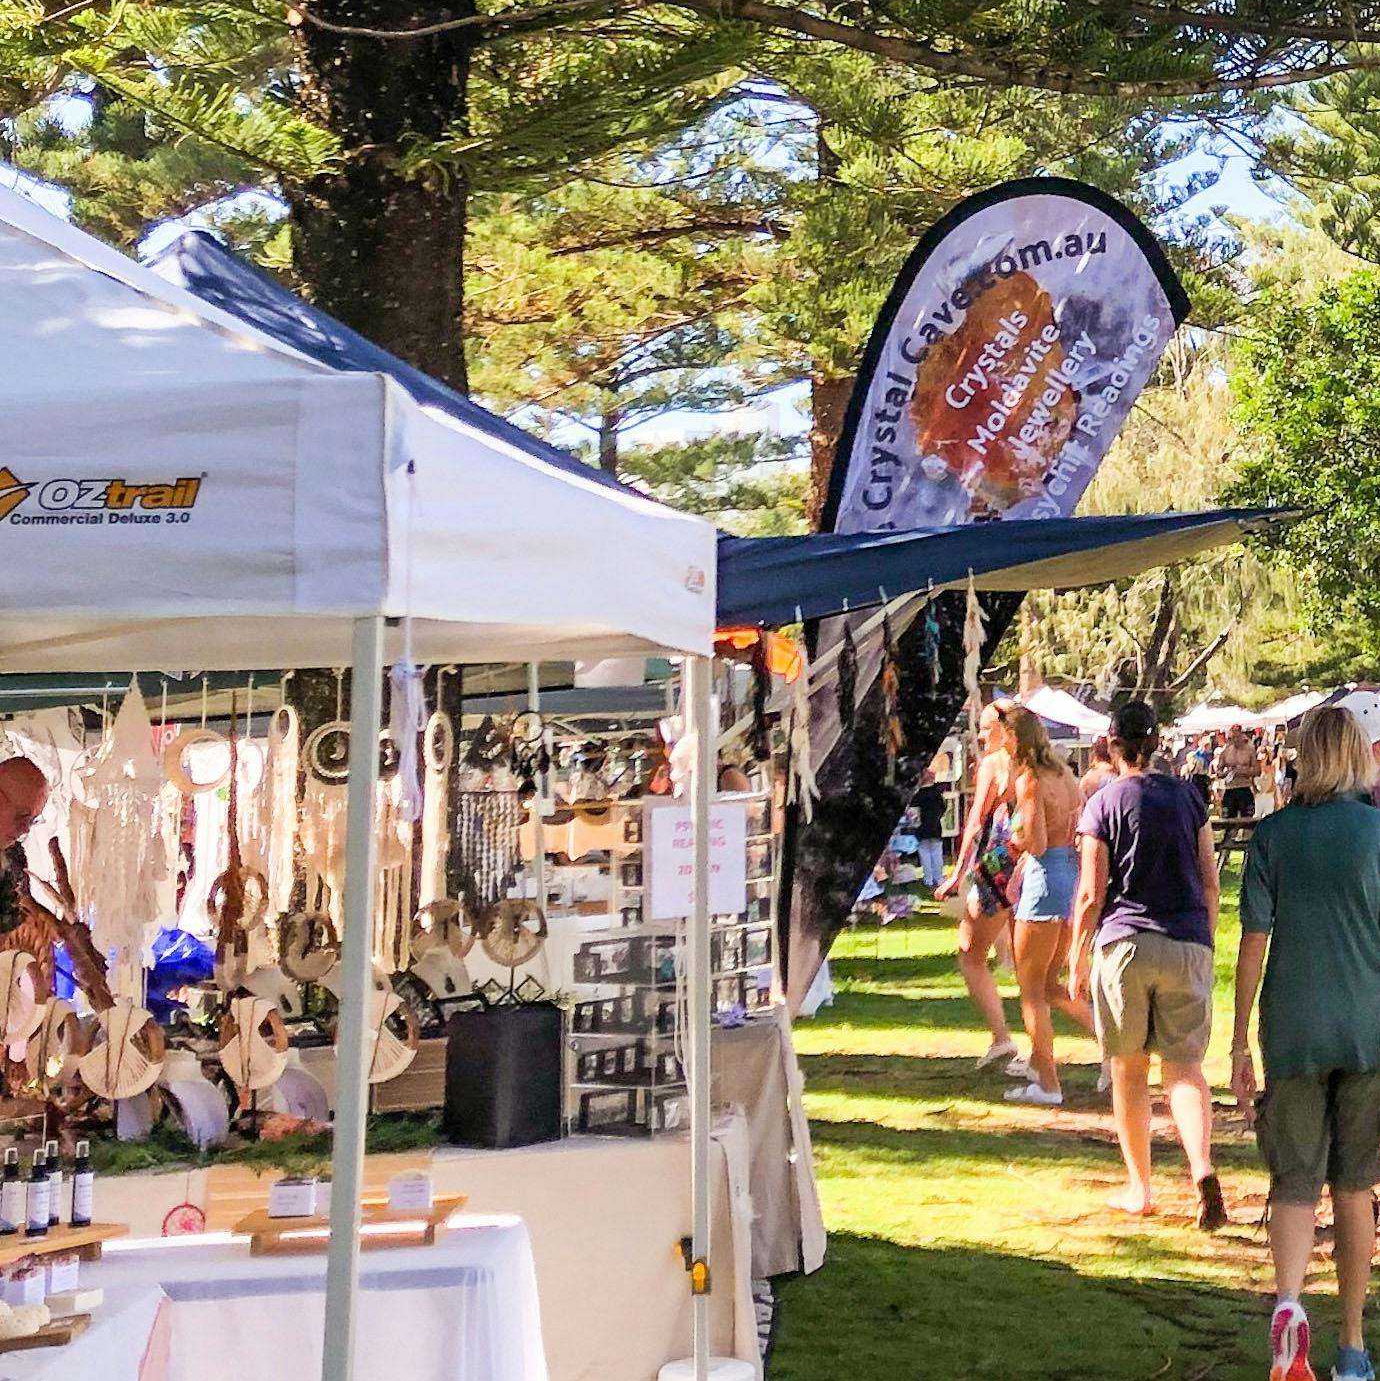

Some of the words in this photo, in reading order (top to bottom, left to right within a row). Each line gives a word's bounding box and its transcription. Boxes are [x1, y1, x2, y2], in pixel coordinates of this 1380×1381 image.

[944, 310, 1029, 409] Crystals
[966, 323, 1061, 456] Moldavite
[1007, 330, 1097, 460] Jewellery
[1075, 313, 1162, 438] Readings
[38, 477, 201, 510] OZtrail
[862, 371, 913, 511] Crystal
[10, 512, 104, 525] Commercial
[108, 512, 162, 524] Deluxe
[165, 511, 191, 524] 3.0
